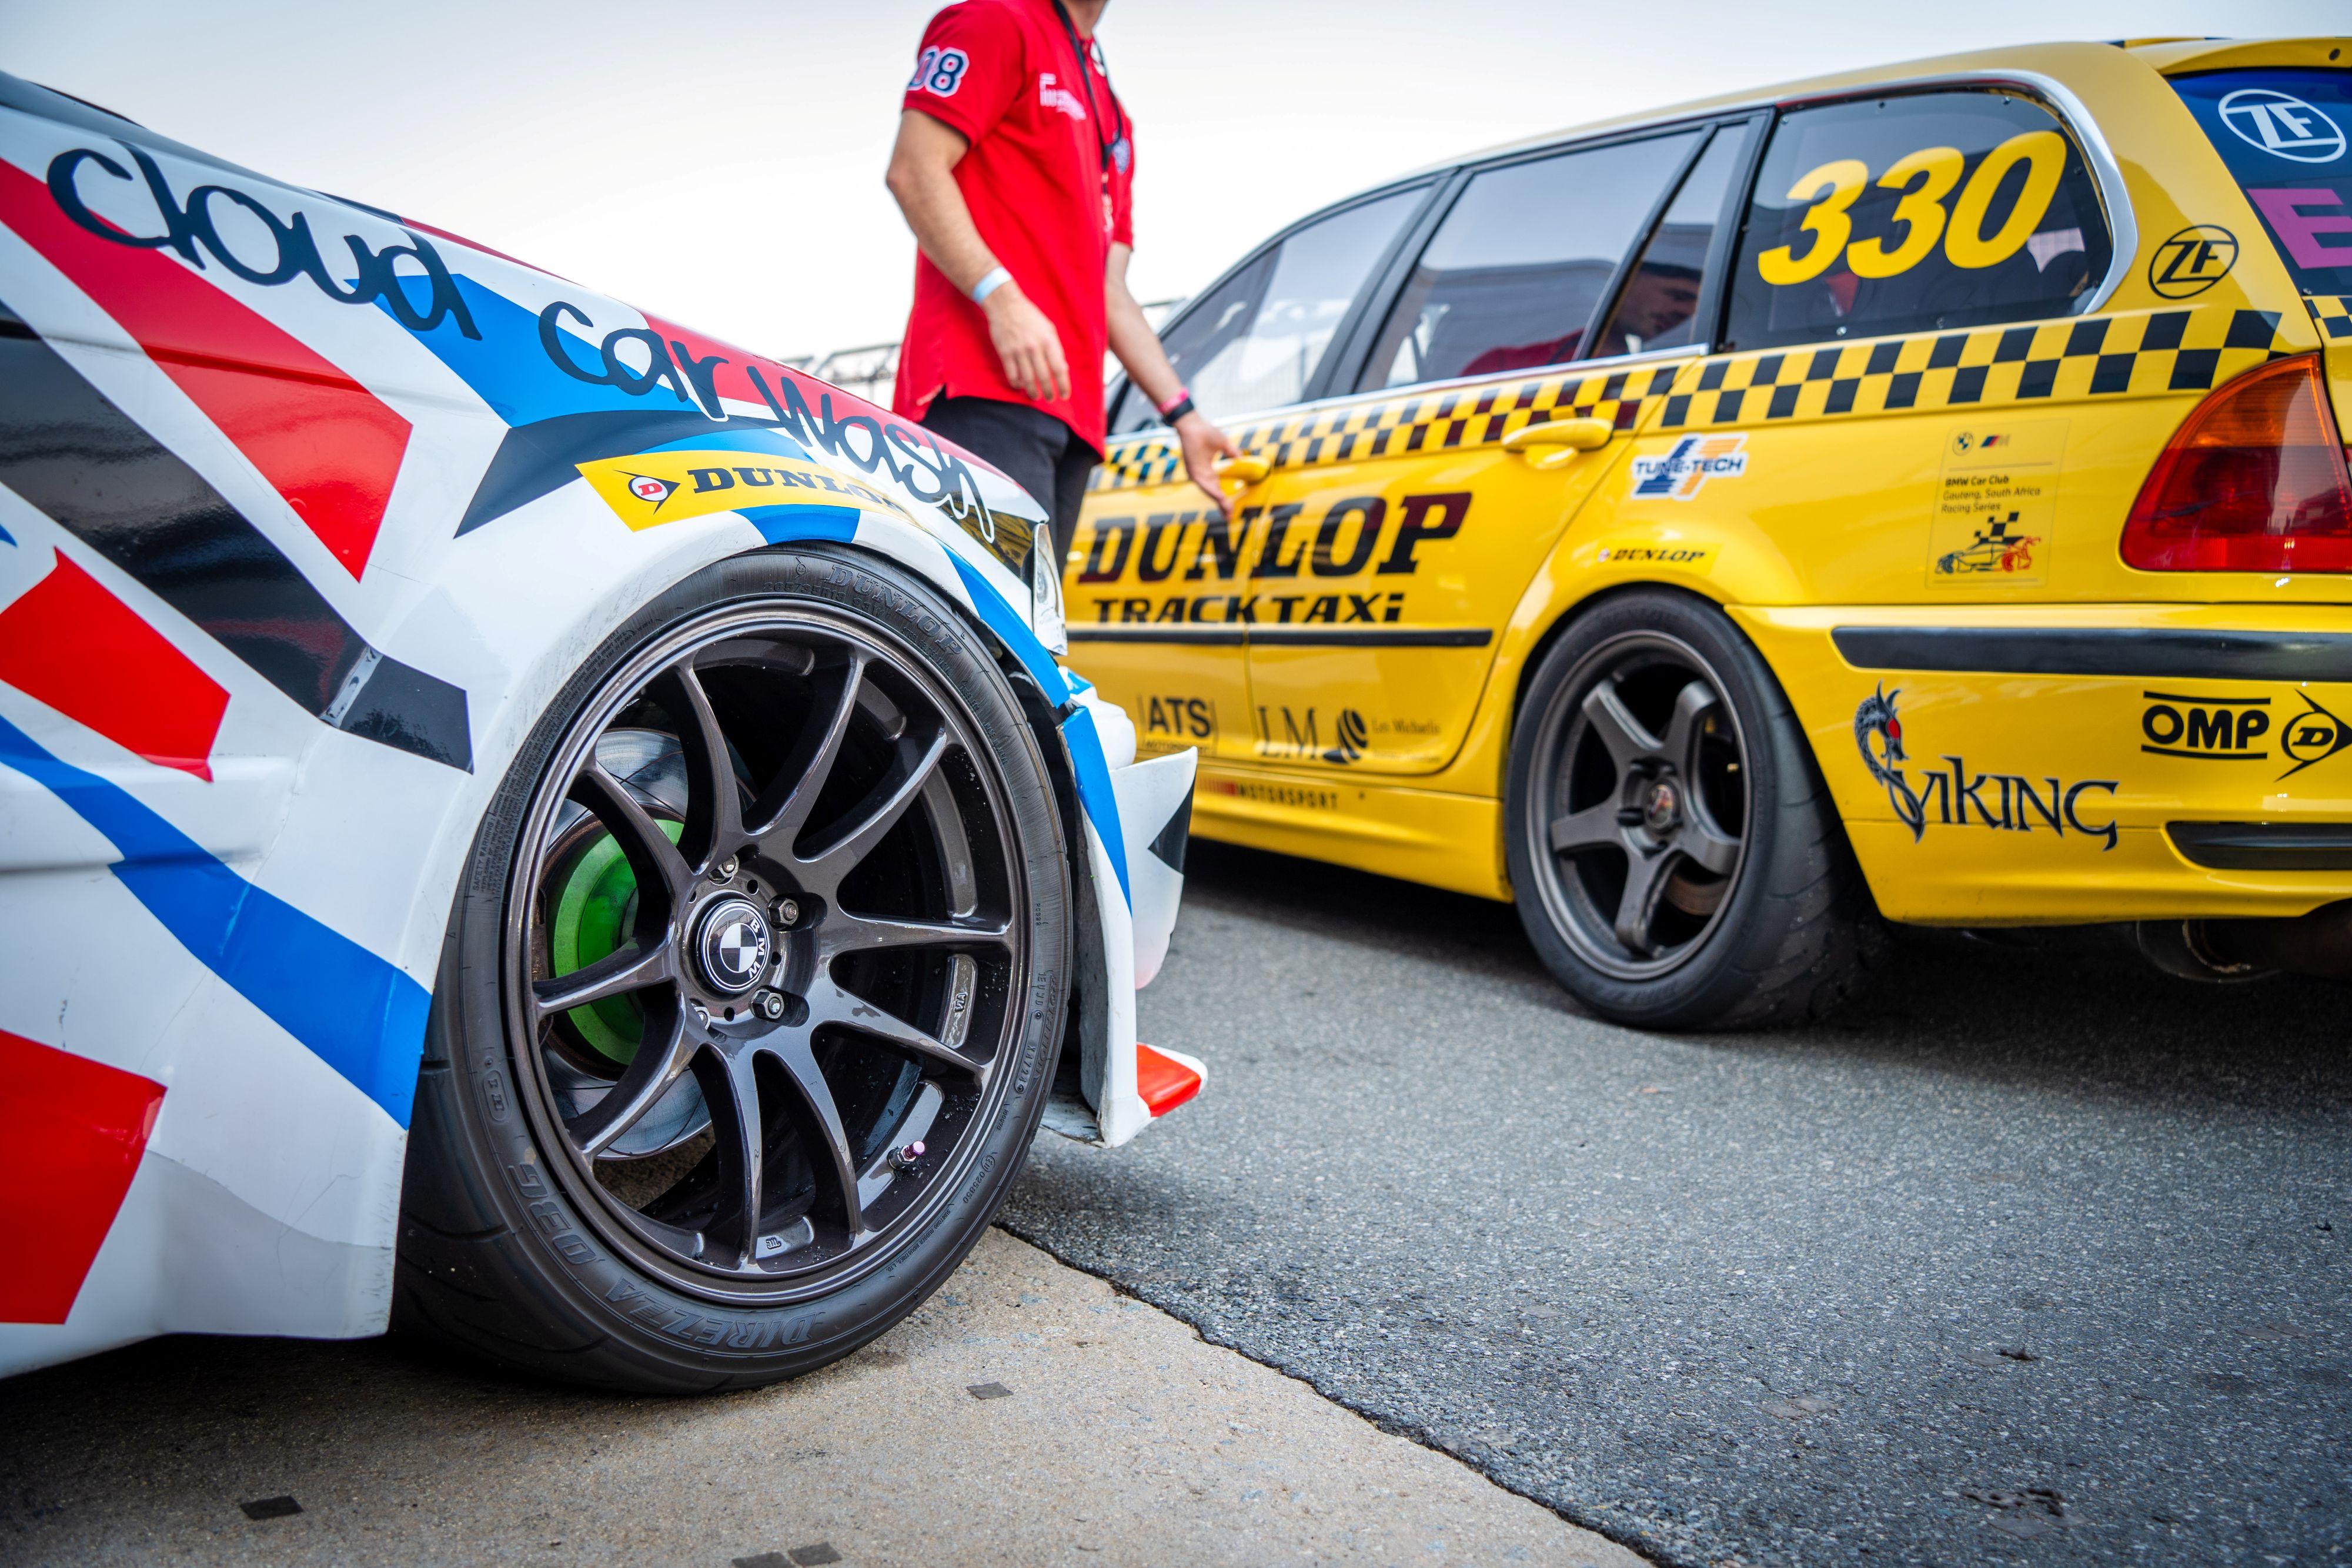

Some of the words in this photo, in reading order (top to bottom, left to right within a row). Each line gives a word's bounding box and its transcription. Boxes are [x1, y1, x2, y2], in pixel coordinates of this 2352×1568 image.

[2226, 101, 2344, 149] ZF
[1758, 131, 2066, 285] 330
[2154, 238, 2236, 286] ZF
[539, 301, 729, 421] car
[1945, 477, 1968, 487] BMW
[1971, 476, 1986, 486] Car
[1989, 474, 2009, 484] Club
[1985, 487, 2010, 498] South
[2013, 486, 2040, 496] Africa
[1941, 503, 1970, 514] Racing
[1973, 502, 2001, 511] Series
[1077, 493, 1472, 584] DUNLOP
[1612, 548, 1705, 563] DUNLOP
[824, 564, 964, 655] DUNLOP
[1149, 696, 1211, 737] ATS
[2141, 704, 2270, 750] OMP
[1238, 783, 1338, 810] MOTORSPORT
[749, 917, 765, 979] BMW
[605, 1276, 818, 1348] DIREZZA
